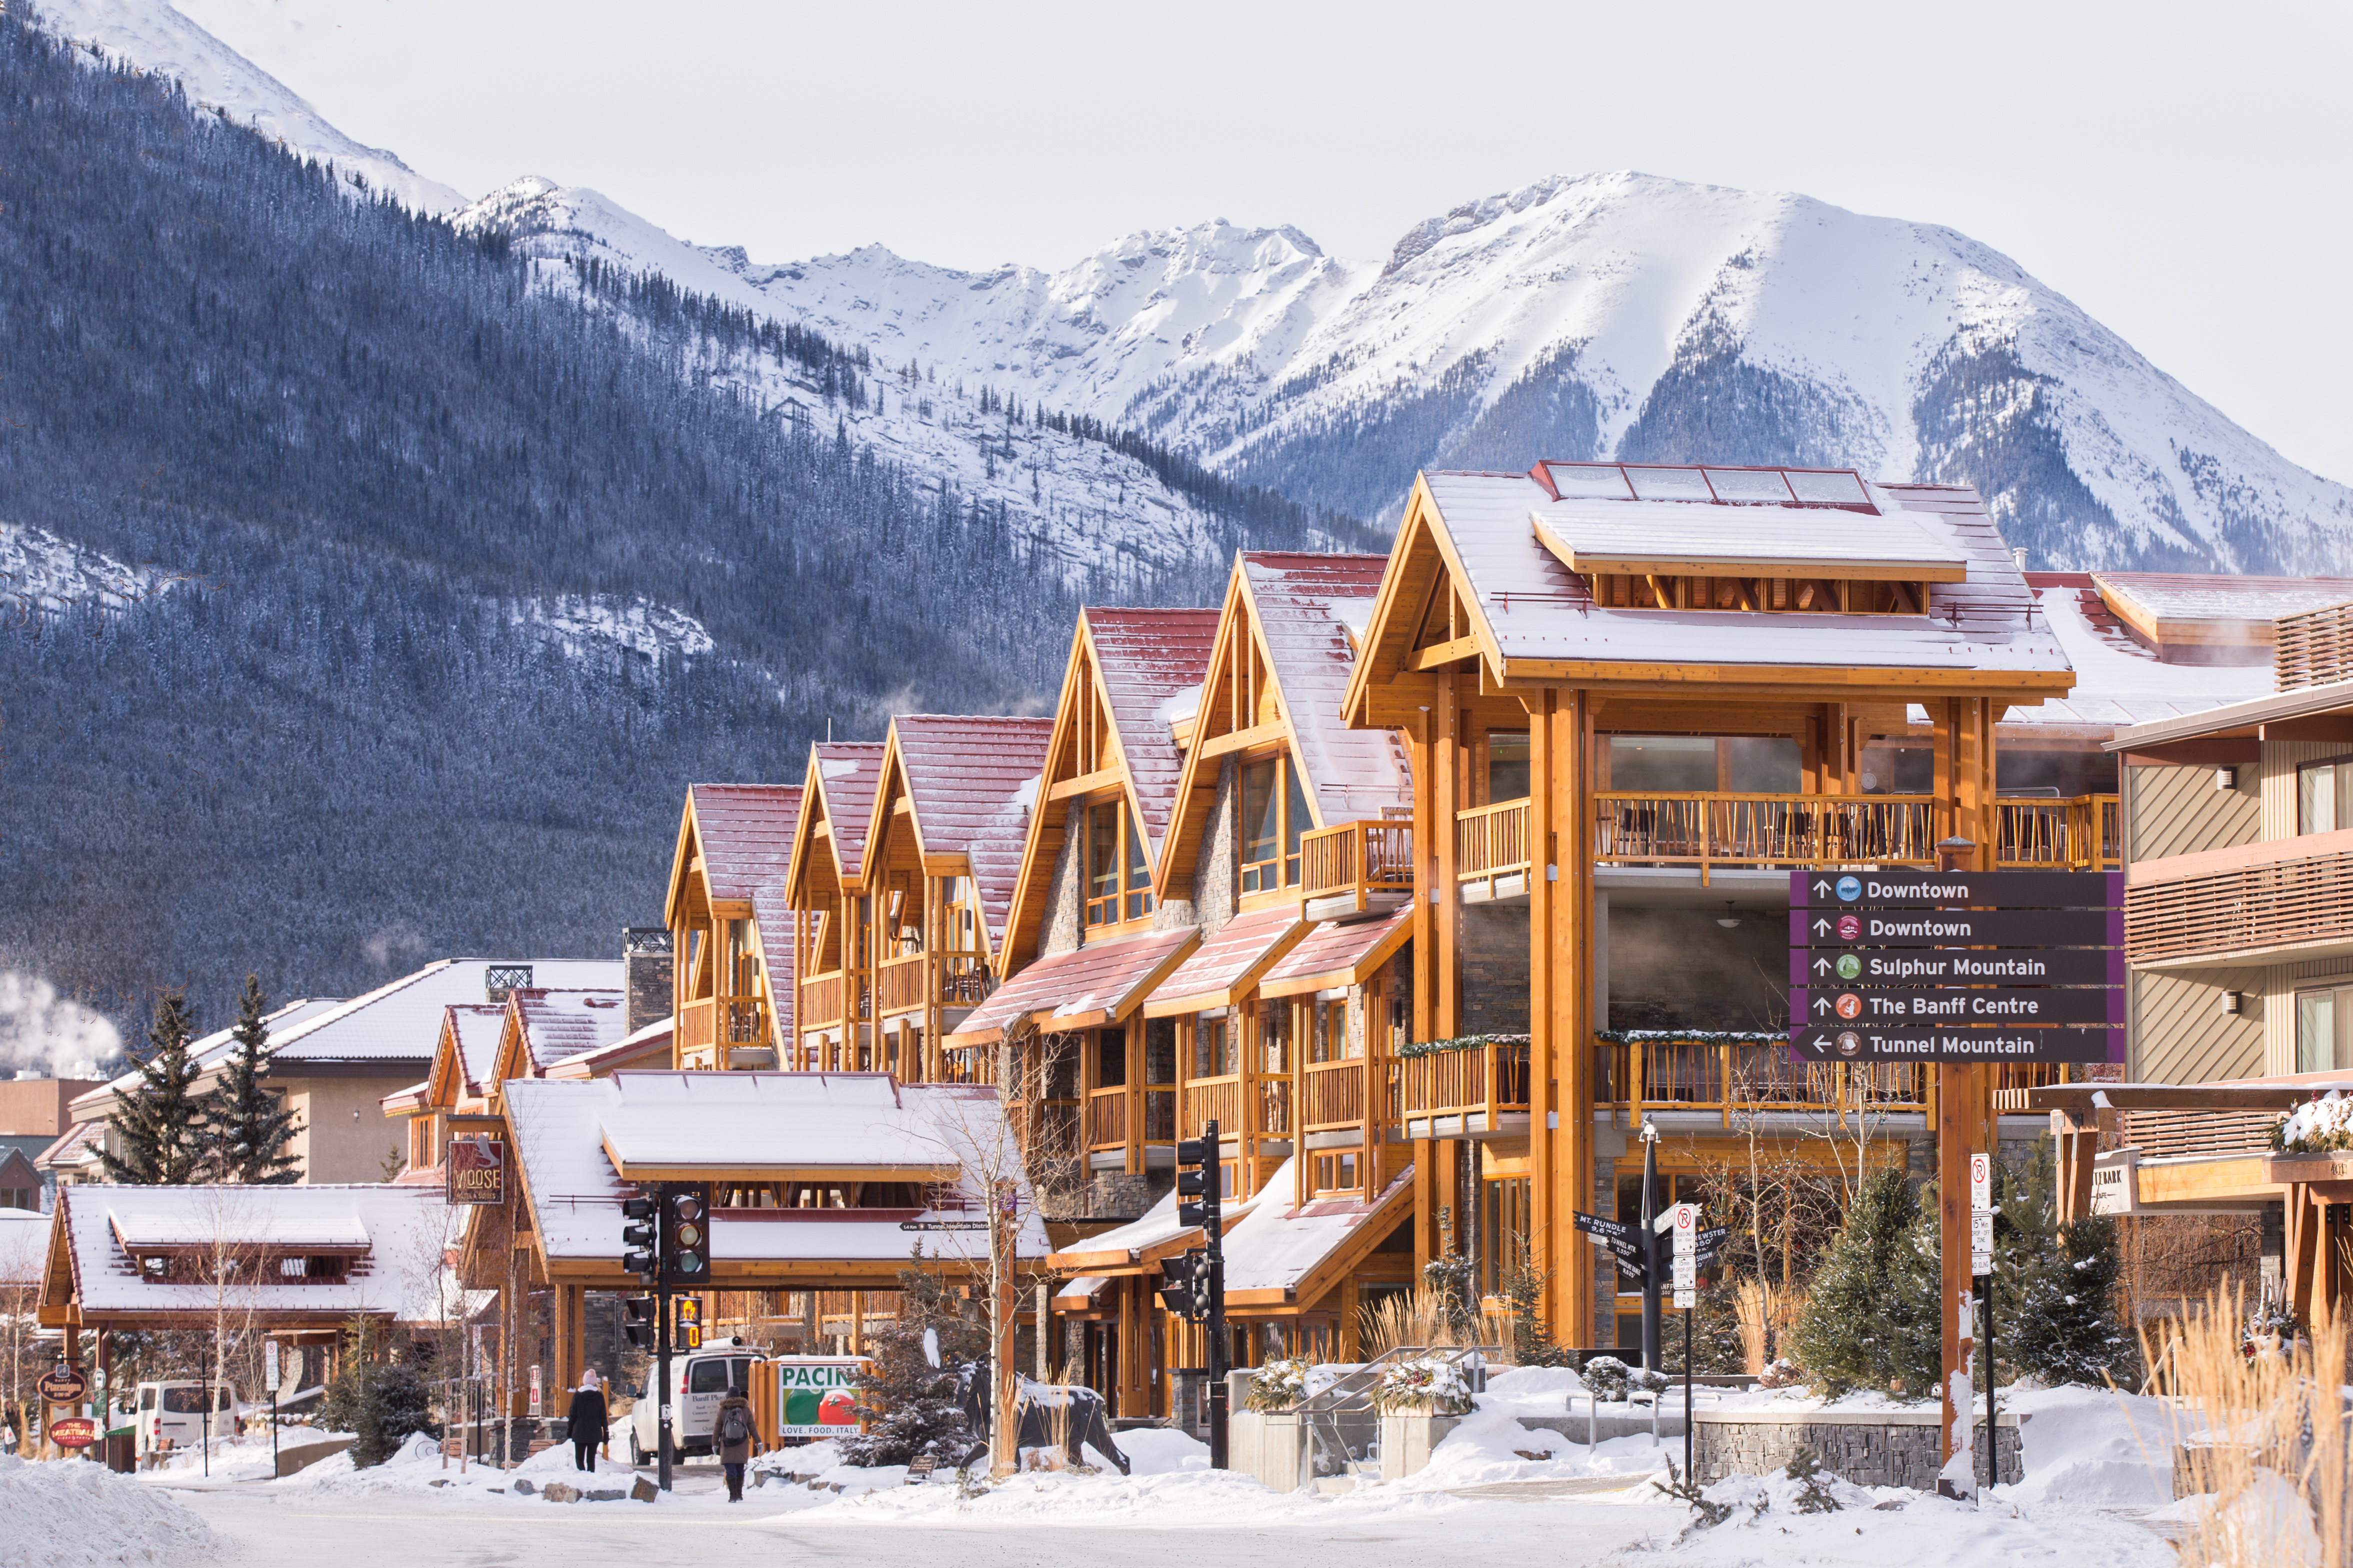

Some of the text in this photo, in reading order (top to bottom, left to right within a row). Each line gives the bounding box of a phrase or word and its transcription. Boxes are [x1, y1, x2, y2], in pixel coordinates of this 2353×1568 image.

[1868, 882, 1968, 898] Downtown
[1871, 920, 1970, 936] Downtown
[1870, 959, 2044, 978] Sulphur Mountain
[1870, 998, 2038, 1014] The Banff Centre
[1870, 1037, 2034, 1053] Tunnel Mountain
[453, 1169, 500, 1189] MOOSE
[2092, 1170, 2122, 1186] TEBARK
[1594, 1219, 1626, 1233] RUNDLE
[1973, 1220, 1978, 1228] 15
[1695, 1229, 1726, 1241] REWSTER
[1611, 1237, 1627, 1249] TUNNEL
[1628, 1244, 1636, 1253] MTN.
[1696, 1251, 1712, 1262] SQUAW
[1632, 1266, 1640, 1276] RANGE
[689, 1327, 699, 1347] 0
[44, 1381, 82, 1394] Ptarmigan
